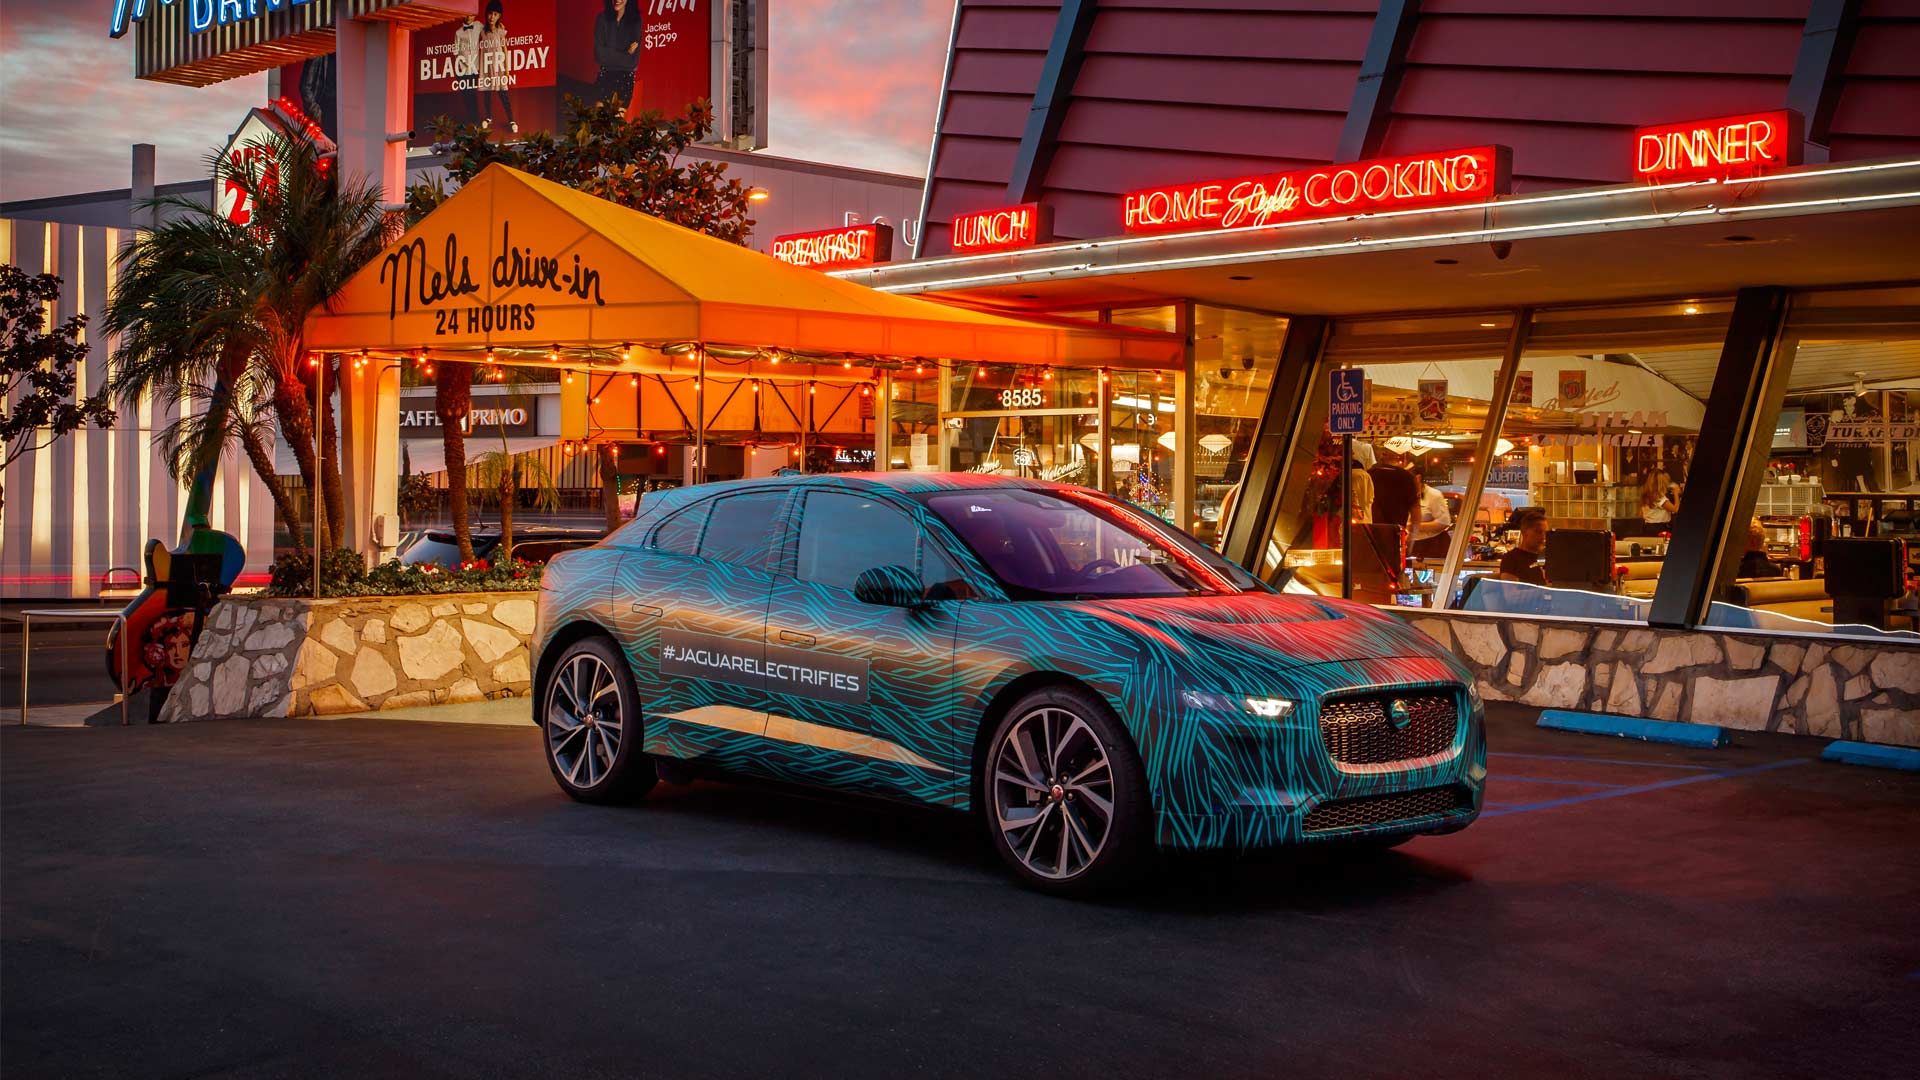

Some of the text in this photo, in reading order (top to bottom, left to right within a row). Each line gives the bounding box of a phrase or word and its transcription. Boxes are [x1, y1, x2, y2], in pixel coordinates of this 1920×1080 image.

[645, 22, 671, 33] Jacket
[426, 46, 434, 55] IN
[534, 34, 543, 44] 24
[420, 46, 550, 80] BLACK FRIDAY
[451, 74, 517, 91] COLLECTION
[1638, 120, 1773, 173] DINNER
[1126, 154, 1479, 228] HOME Style COOKING
[954, 209, 1028, 247] LUNCH
[773, 229, 869, 266] BREAKFAST
[380, 220, 606, 320] Mels drive-in
[435, 303, 536, 335] 24 HOURS
[1002, 388, 1042, 407] 8585
[1331, 401, 1362, 415] PARKING
[470, 408, 526, 426] PRIMO
[1337, 416, 1356, 430] ONLY
[663, 644, 860, 693] #JAGUARELECTRIFIES
